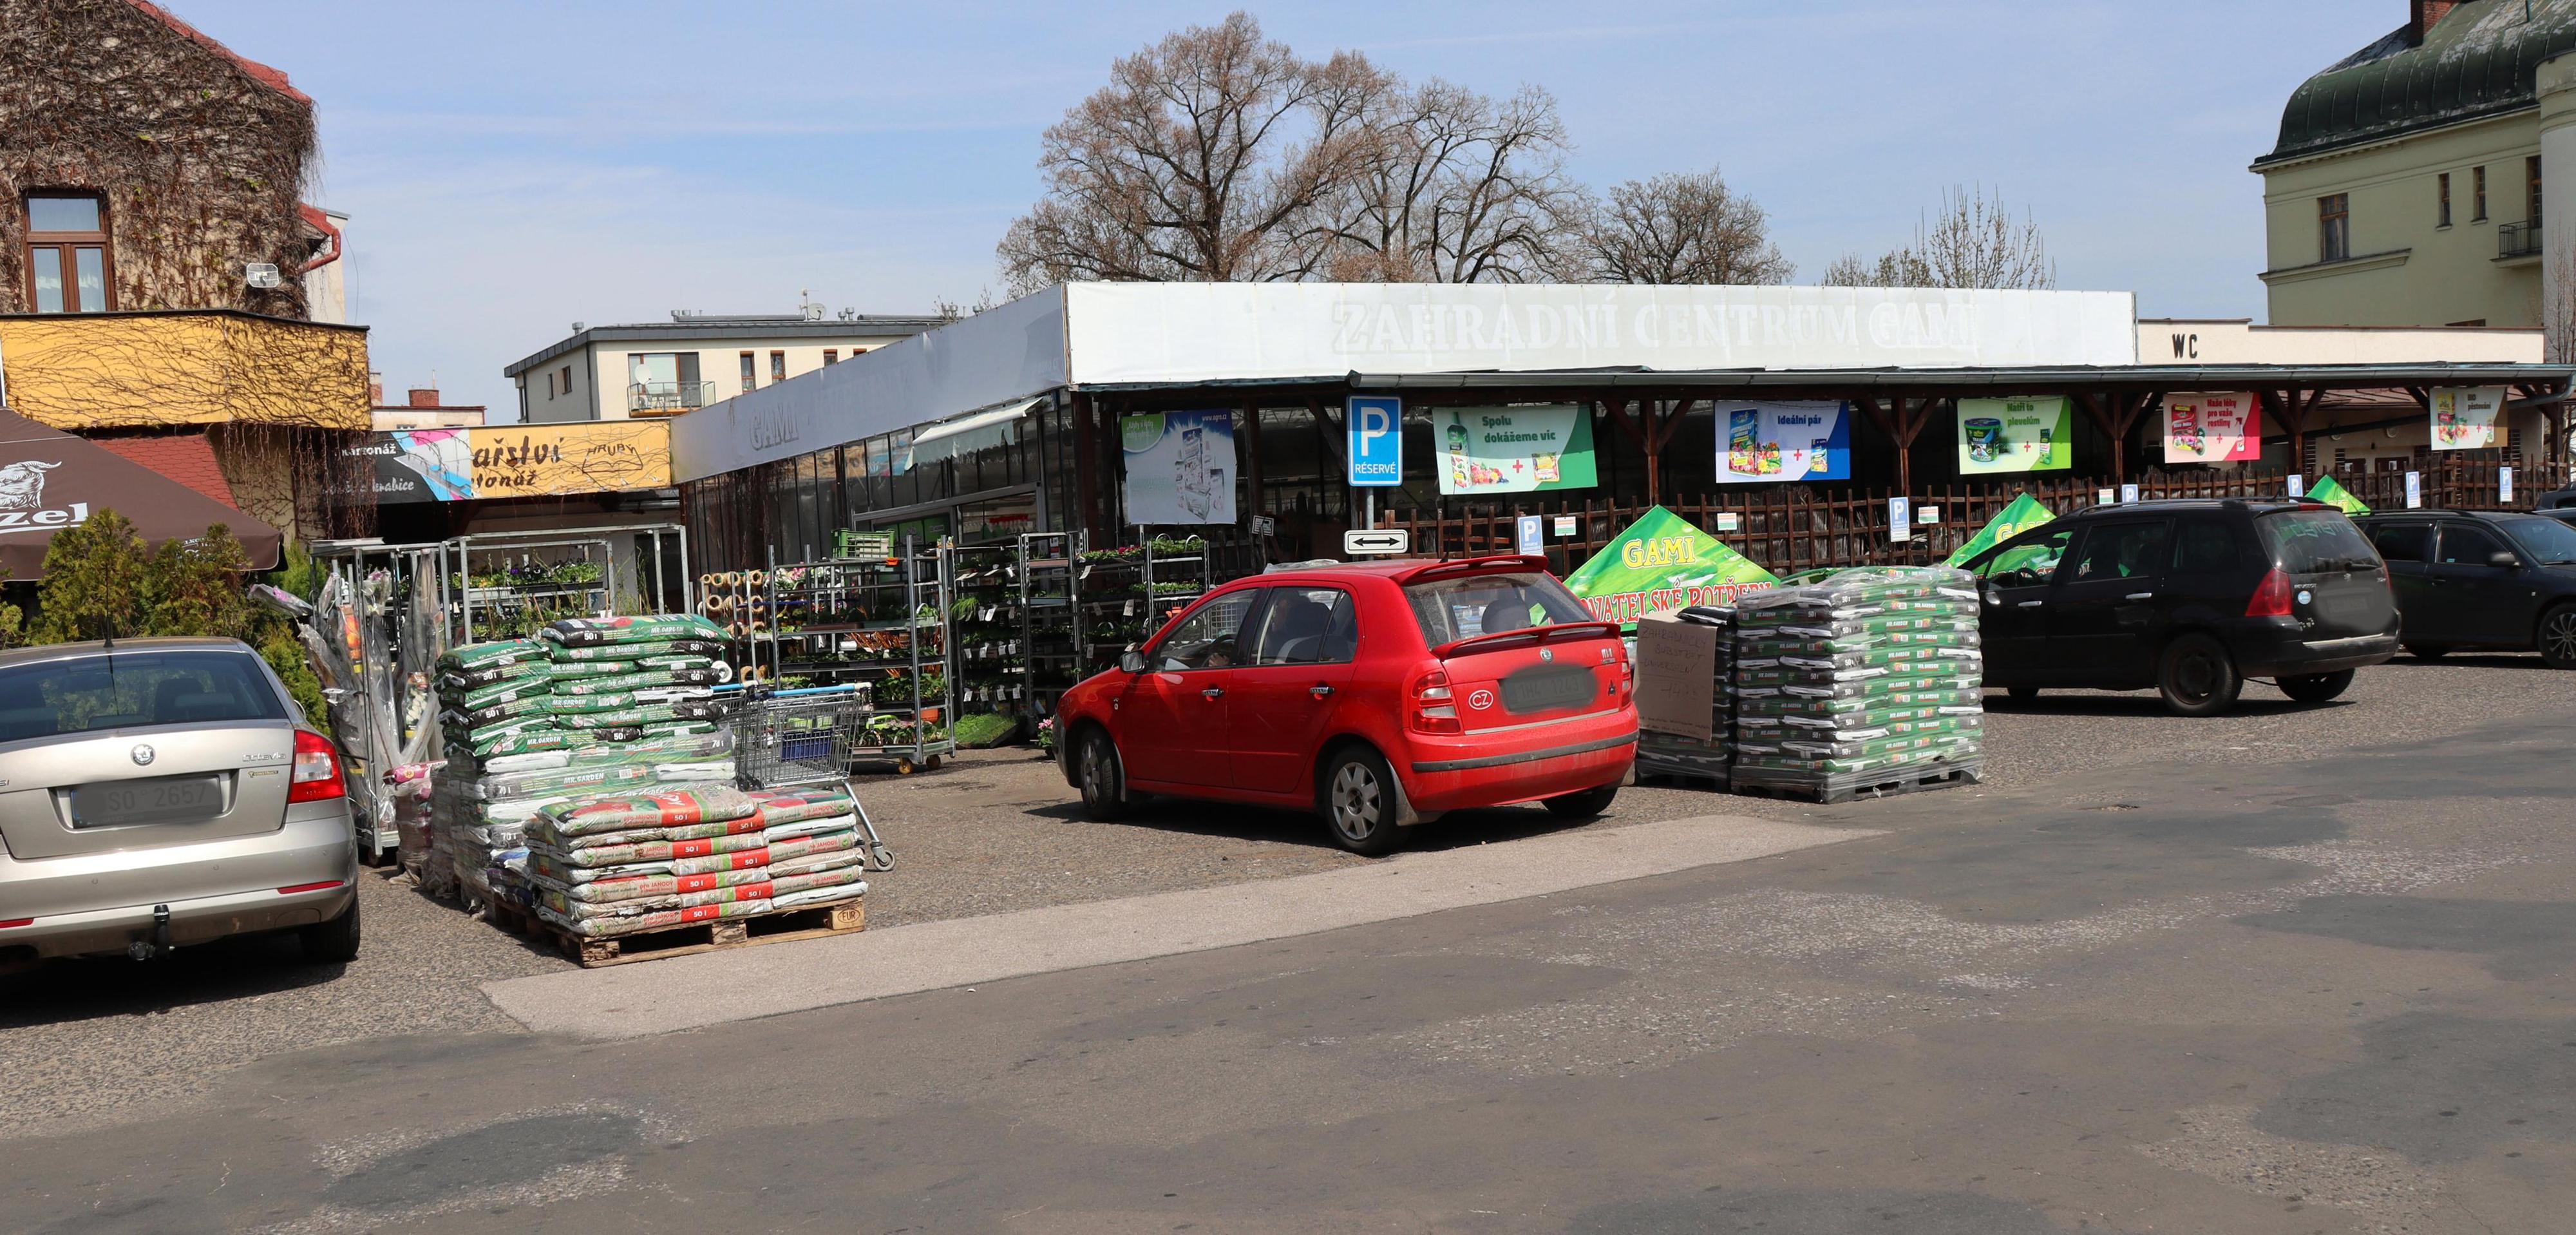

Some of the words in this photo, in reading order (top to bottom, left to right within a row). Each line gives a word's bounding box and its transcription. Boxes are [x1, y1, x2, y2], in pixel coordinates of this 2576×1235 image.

[1332, 291, 1620, 354] ZAHRADNÍ
[1634, 302, 1859, 349] CENTRUM
[1870, 301, 1976, 349] GAMI
[2172, 334, 2198, 359] WC
[2207, 398, 2222, 407] Naše
[750, 397, 799, 450] GAMI
[1482, 416, 1511, 428] Spolu
[1777, 415, 1806, 425] Ideální
[1808, 415, 1822, 426] pár
[2208, 419, 2231, 428] rostliny
[1361, 407, 1390, 456] P
[1484, 431, 1538, 443] dokážeme
[1540, 430, 1556, 441] víc
[587, 443, 635, 456] HRUBÝ
[1355, 461, 1396, 474] RÉSERVÉ
[2291, 479, 2299, 494] P
[1894, 501, 1904, 520] P
[1524, 521, 1536, 542] P
[1622, 536, 1696, 569] GAMI
[1471, 693, 1490, 706] CZ
[842, 910, 857, 919] EUR
